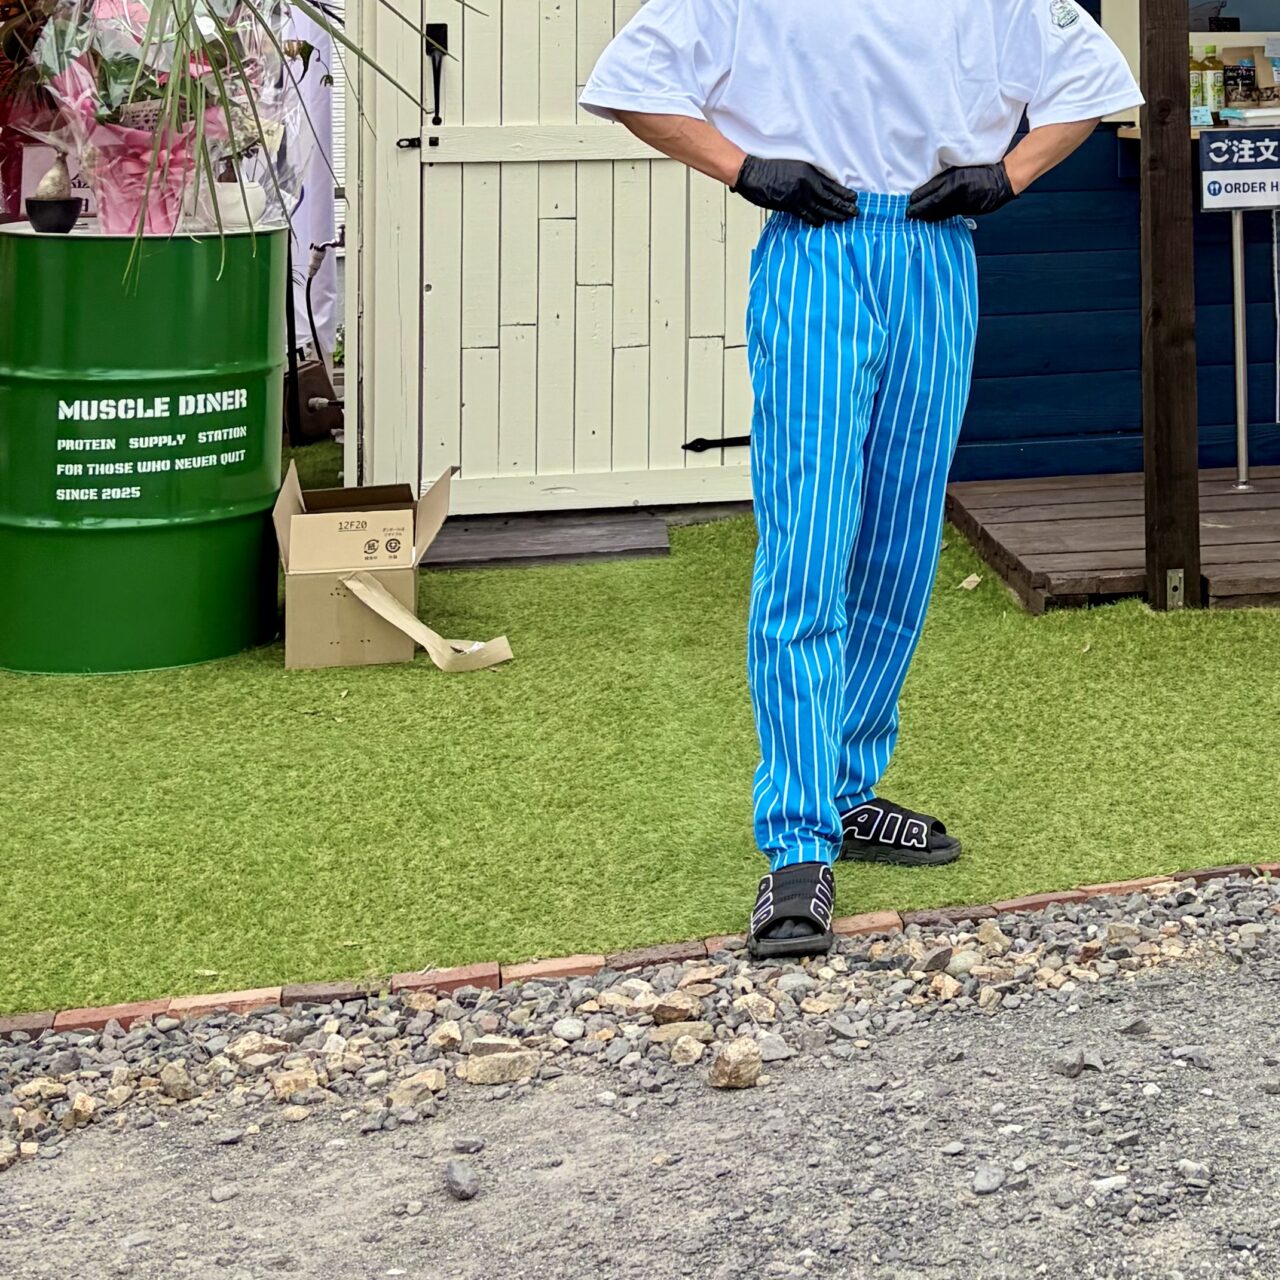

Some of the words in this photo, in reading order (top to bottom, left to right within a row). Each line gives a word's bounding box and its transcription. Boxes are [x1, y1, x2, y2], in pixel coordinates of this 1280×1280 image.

[1224, 182, 1267, 194] ORDER
[58, 398, 170, 421] MUSCLE
[178, 389, 247, 416] DINER
[57, 438, 116, 451] PROTEIN
[128, 434, 187, 449] SUPPLY
[198, 426, 247, 444] STATION
[56, 463, 83, 476] FOR
[87, 462, 134, 475] THOSE
[137, 459, 171, 473] WHO
[175, 454, 217, 470] NEVER
[220, 449, 246, 466] QUIT
[56, 488, 98, 500] SINCE
[101, 486, 141, 500] 2025
[338, 520, 368, 530] 12F20
[840, 805, 928, 848] AIR
